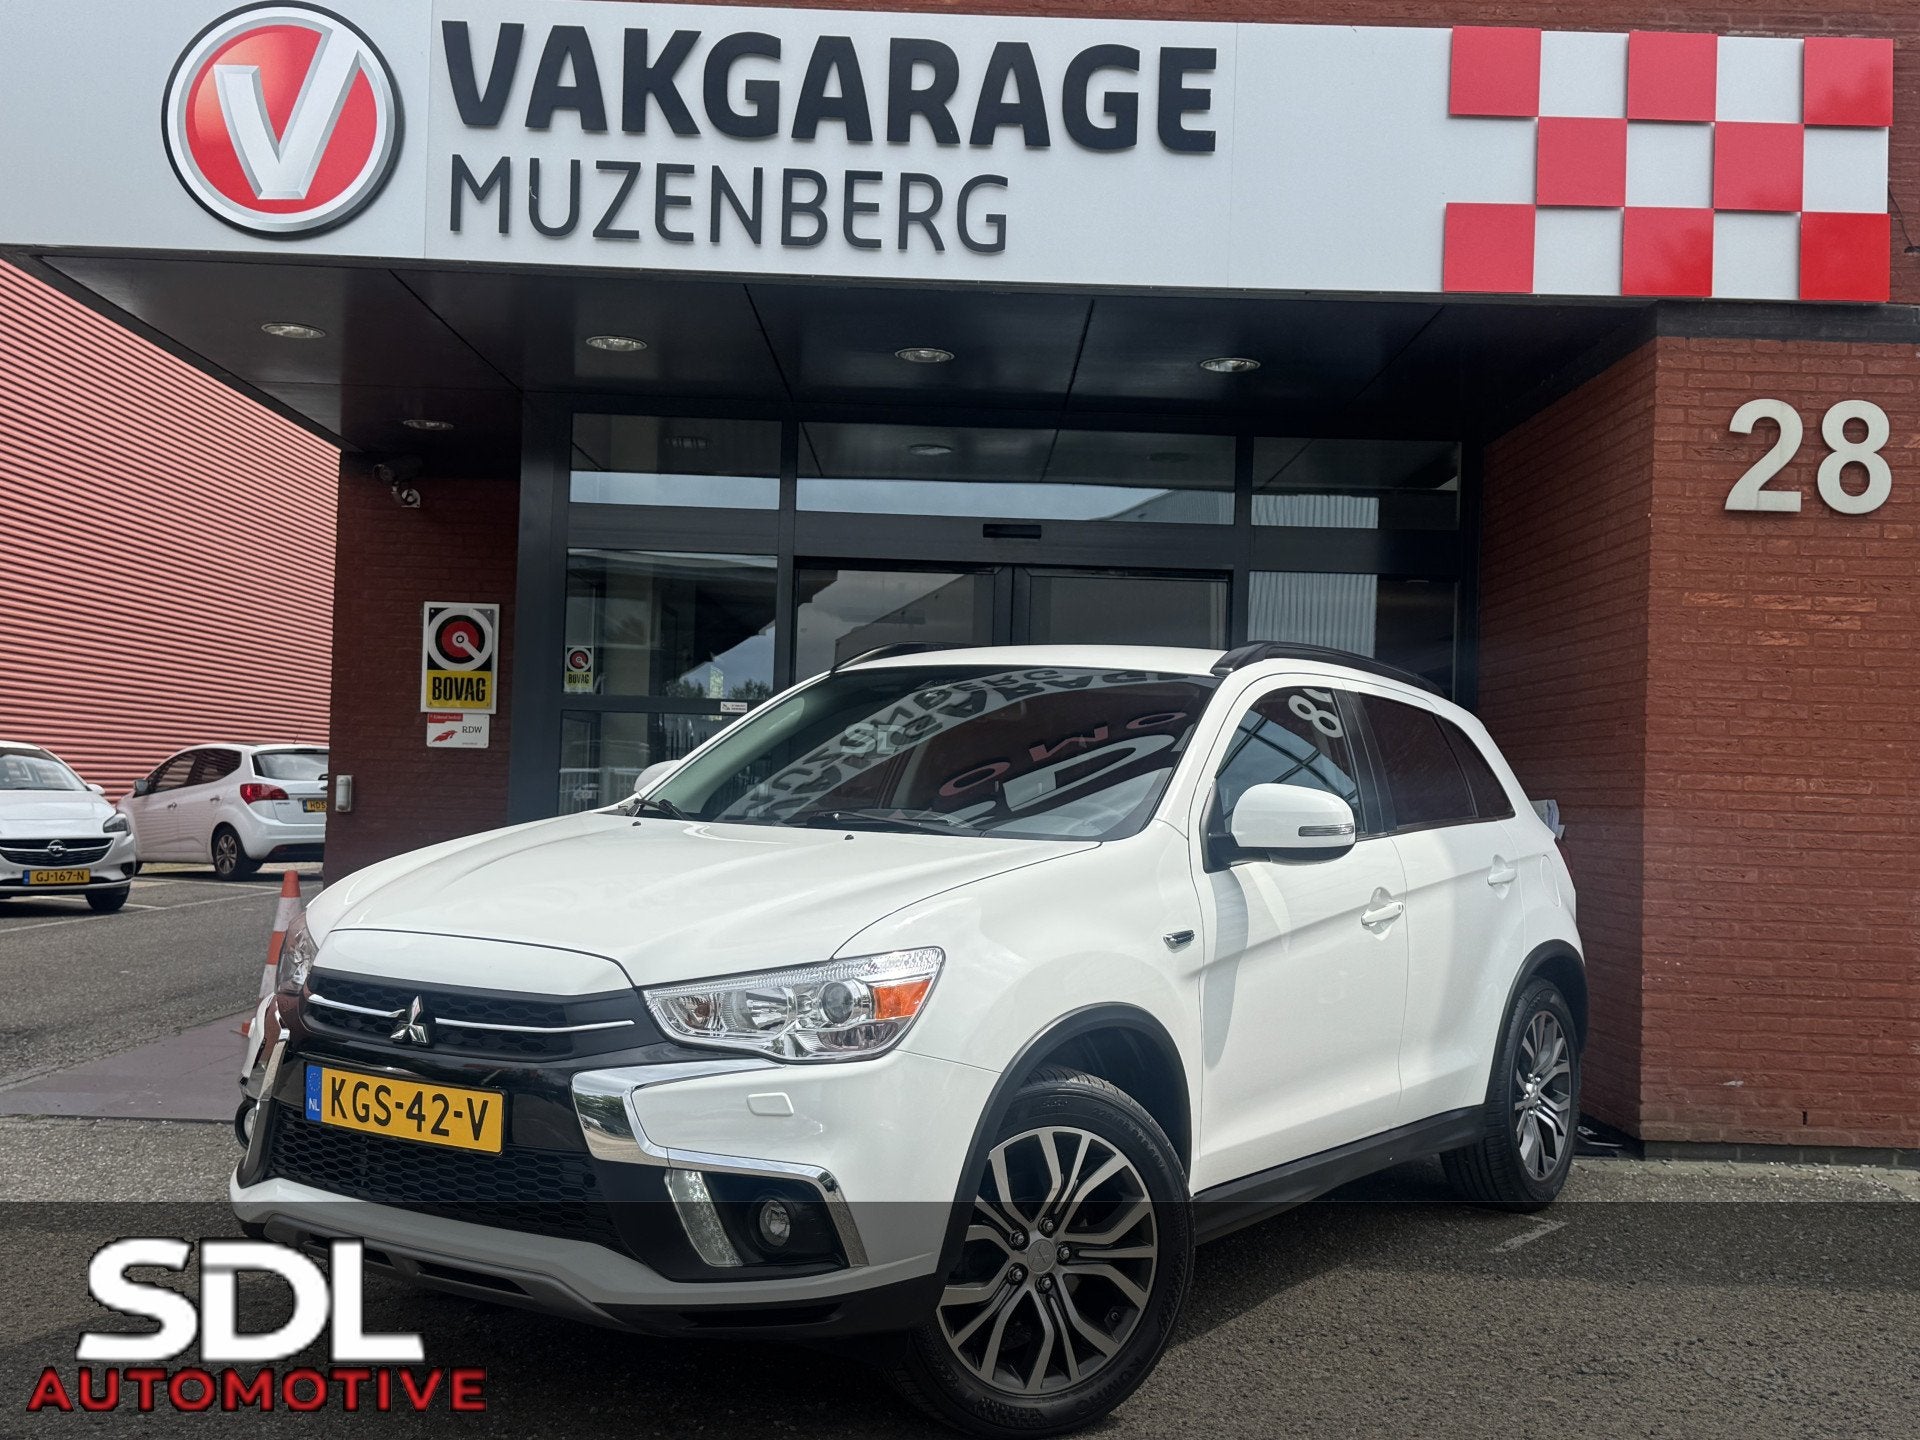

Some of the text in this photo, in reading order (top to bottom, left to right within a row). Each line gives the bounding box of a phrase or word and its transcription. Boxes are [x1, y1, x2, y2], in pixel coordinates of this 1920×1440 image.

[442, 20, 1217, 153] VAKGARAGE
[450, 153, 1009, 254] MUZENBERG
[1724, 398, 1893, 515] 28
[432, 676, 486, 702] BOVAG
[568, 673, 590, 684] BOVAG
[462, 725, 483, 734] RDW
[36, 870, 85, 882] GJ-167-N
[308, 1098, 320, 1112] NL
[331, 1076, 489, 1141] KGS-42-V
